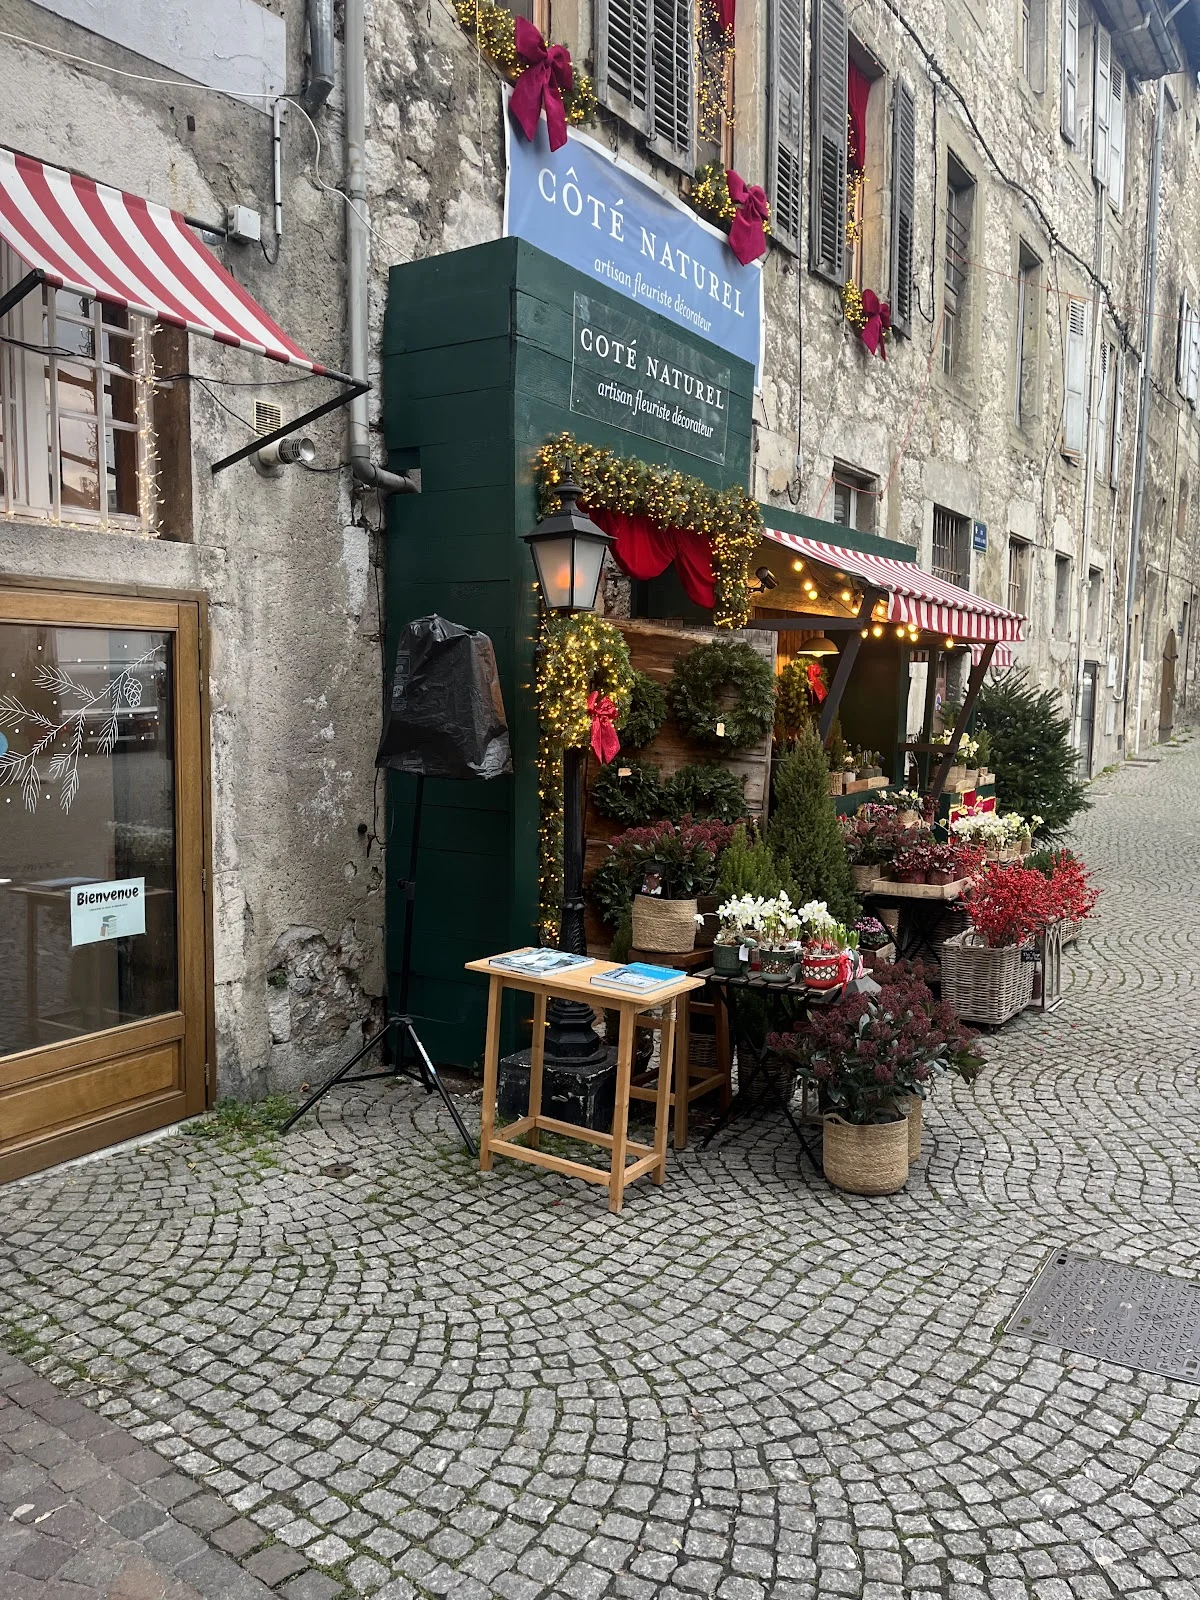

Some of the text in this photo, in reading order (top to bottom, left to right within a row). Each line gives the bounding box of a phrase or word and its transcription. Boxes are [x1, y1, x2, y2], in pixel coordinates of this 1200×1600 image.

[538, 166, 745, 318] CÔTÉ NATUREL
[594, 258, 712, 333] artisan fleuriste décorateur
[580, 328, 725, 410] COTÉ NATUREL
[598, 381, 714, 438] artisan fleuriste décorateur
[77, 887, 139, 906] Bienvenue
